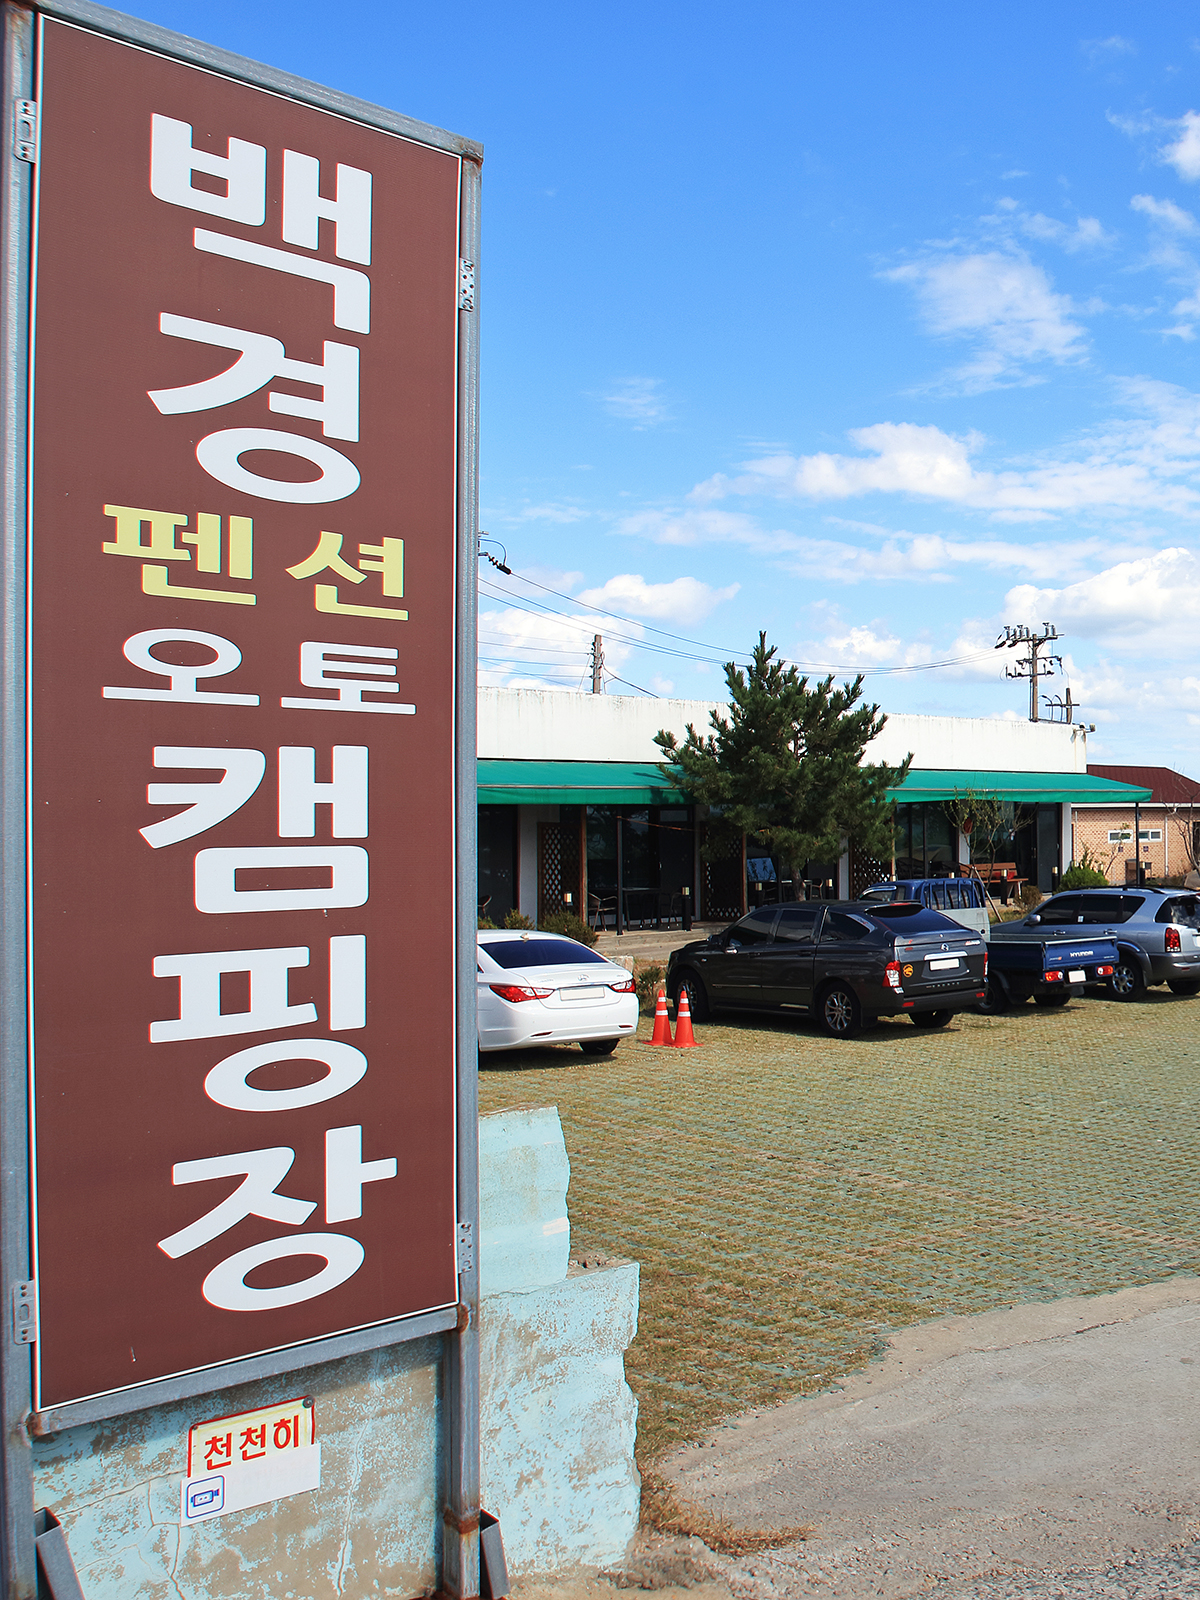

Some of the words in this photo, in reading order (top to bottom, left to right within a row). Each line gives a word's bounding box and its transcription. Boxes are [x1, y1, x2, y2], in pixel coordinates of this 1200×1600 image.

[147, 113, 373, 503] 백경
[103, 504, 409, 621] 펜션
[103, 629, 416, 714] 오토
[139, 746, 398, 1311] 캠핑장
[204, 1414, 299, 1471] 천천히
